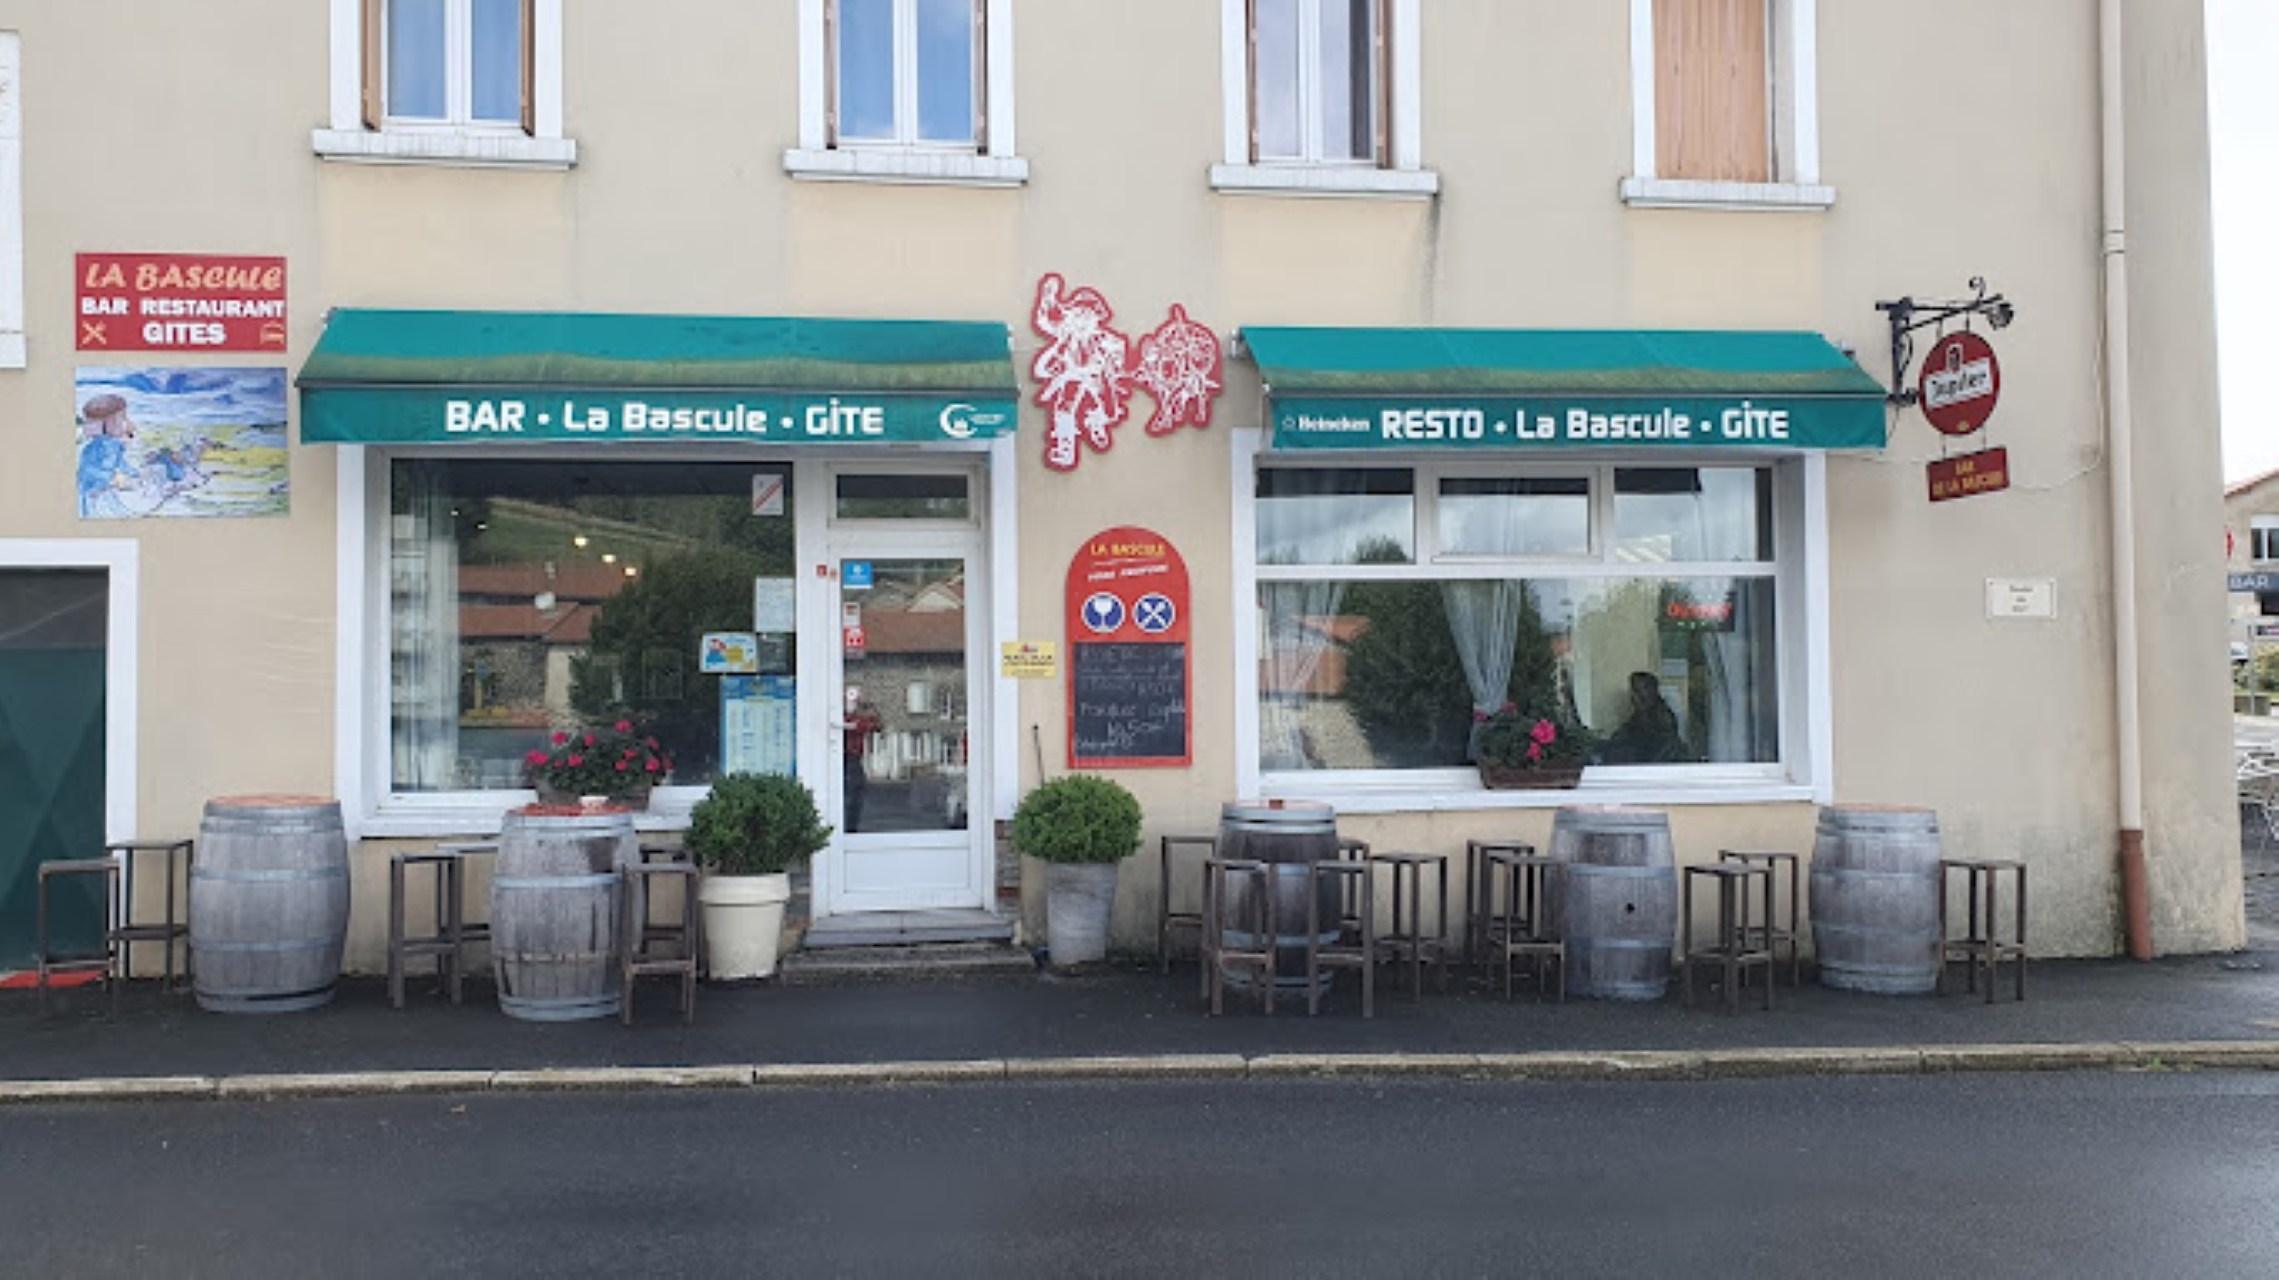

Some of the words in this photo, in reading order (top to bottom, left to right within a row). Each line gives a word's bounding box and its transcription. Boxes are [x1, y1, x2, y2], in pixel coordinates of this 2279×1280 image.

[81, 297, 129, 316] BAR
[140, 299, 285, 318] RESTAURANT
[142, 322, 227, 345] GITES
[445, 401, 525, 432] BAR
[563, 401, 609, 432] La
[622, 402, 767, 433] Bascule
[1381, 409, 1484, 439] RESTO
[1516, 408, 1555, 439] La
[1566, 407, 1690, 439] Bascule
[1091, 544, 1109, 556] LA
[2230, 575, 2269, 589] BAR
